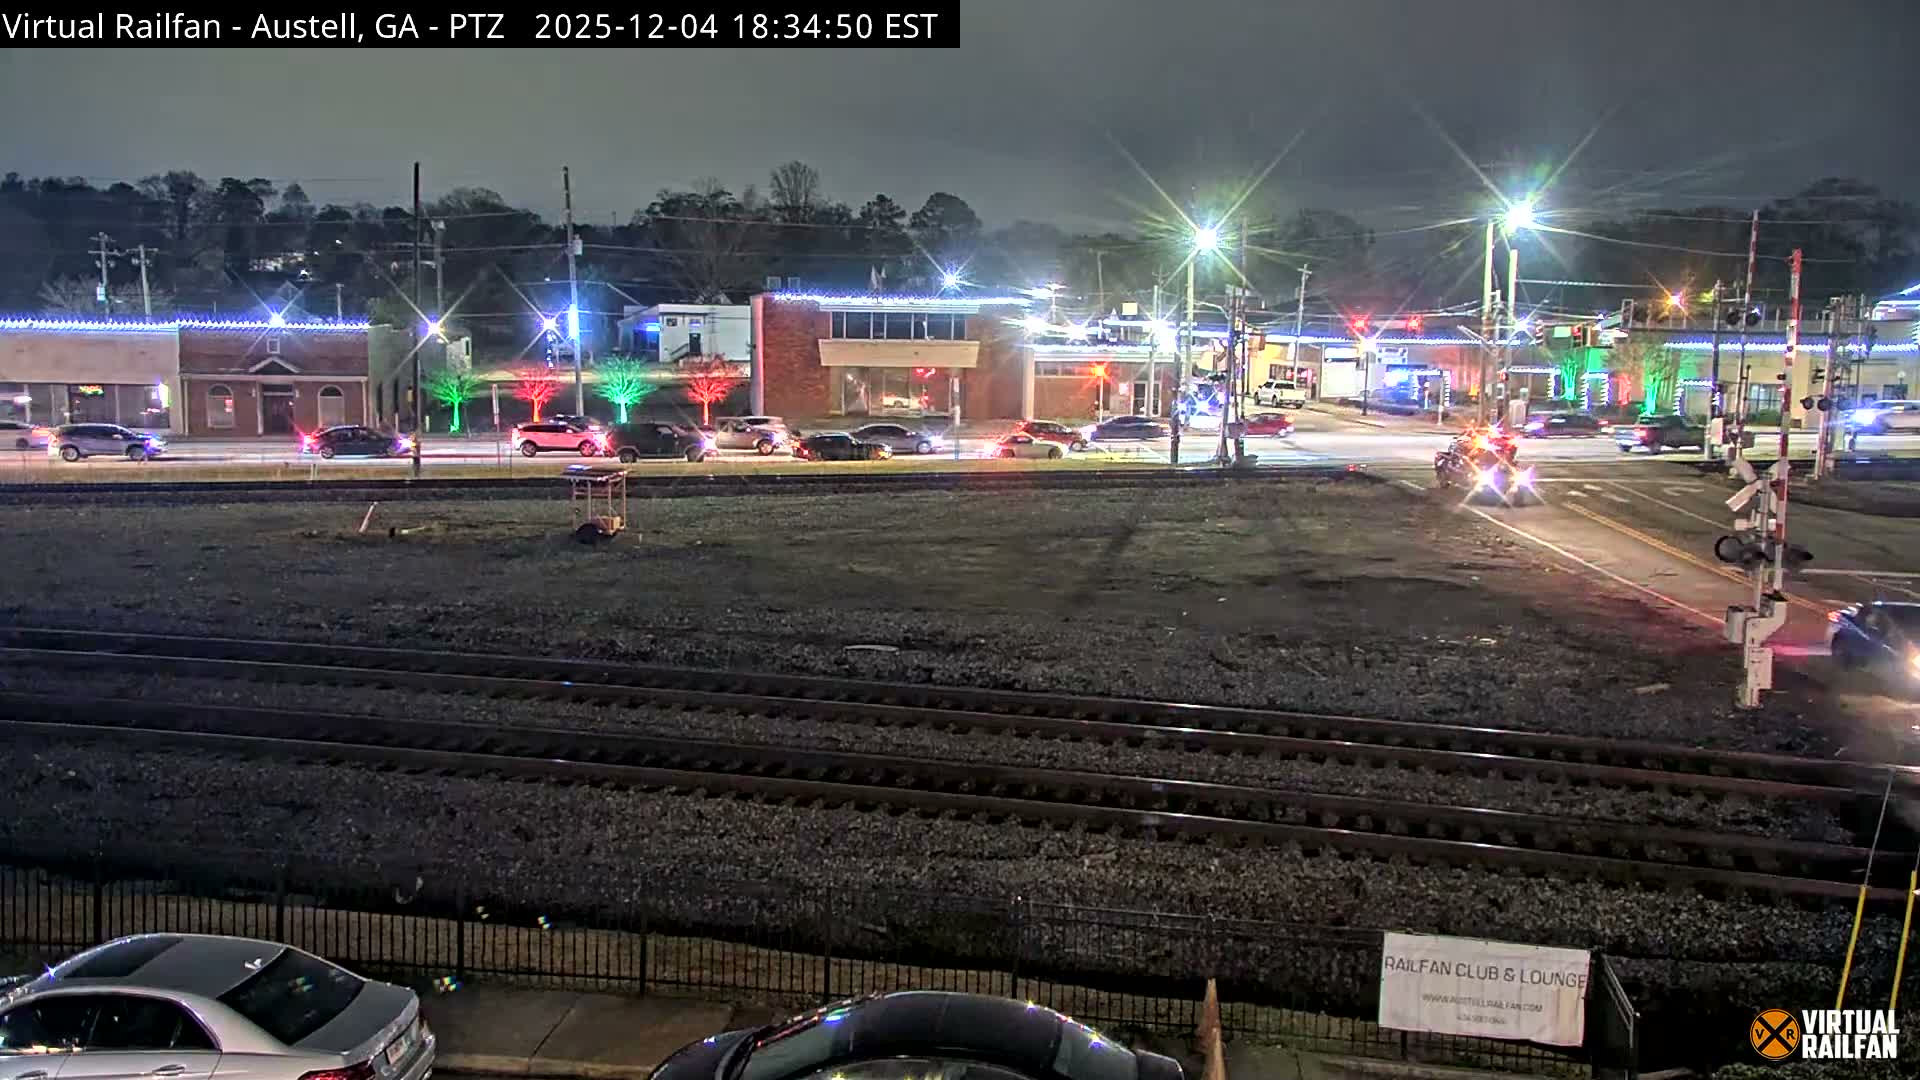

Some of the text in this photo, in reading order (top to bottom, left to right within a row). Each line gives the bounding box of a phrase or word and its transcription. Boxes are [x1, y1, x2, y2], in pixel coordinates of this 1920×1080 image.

[1384, 956, 1586, 989] RAILFAN CLUB & LOUNGE
